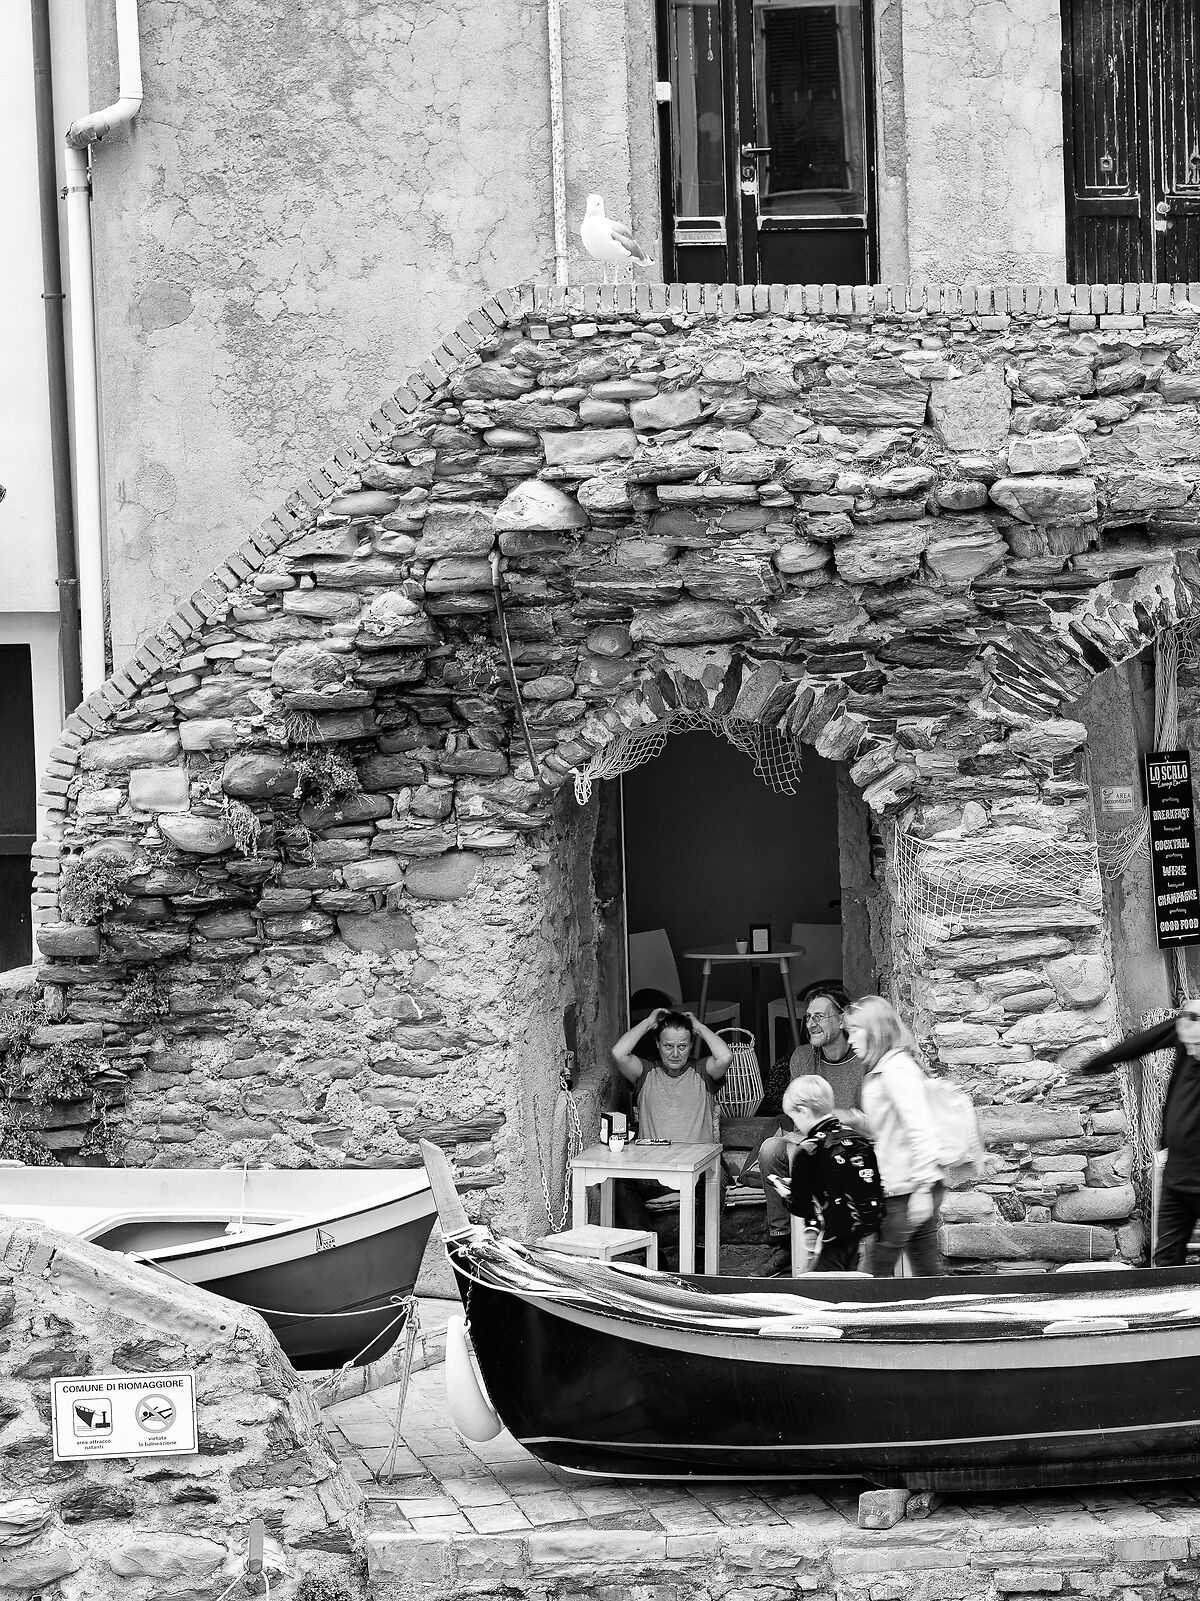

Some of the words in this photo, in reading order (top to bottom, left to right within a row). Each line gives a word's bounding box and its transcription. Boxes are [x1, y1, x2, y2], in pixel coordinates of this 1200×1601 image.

[1149, 766, 1160, 782] LO
[1161, 764, 1188, 781] SCALO
[1153, 808, 1190, 821] BREAKFAST
[1155, 838, 1190, 851] COCKTAIL
[1162, 865, 1187, 876] WINE
[1158, 889, 1198, 907] CHAMPAGNE
[1160, 920, 1180, 932] GOOD
[1180, 918, 1199, 930] FOOD
[62, 1384, 104, 1393] COMUNE
[106, 1383, 116, 1391] DI
[118, 1380, 184, 1391] RIOMAGGIORE
